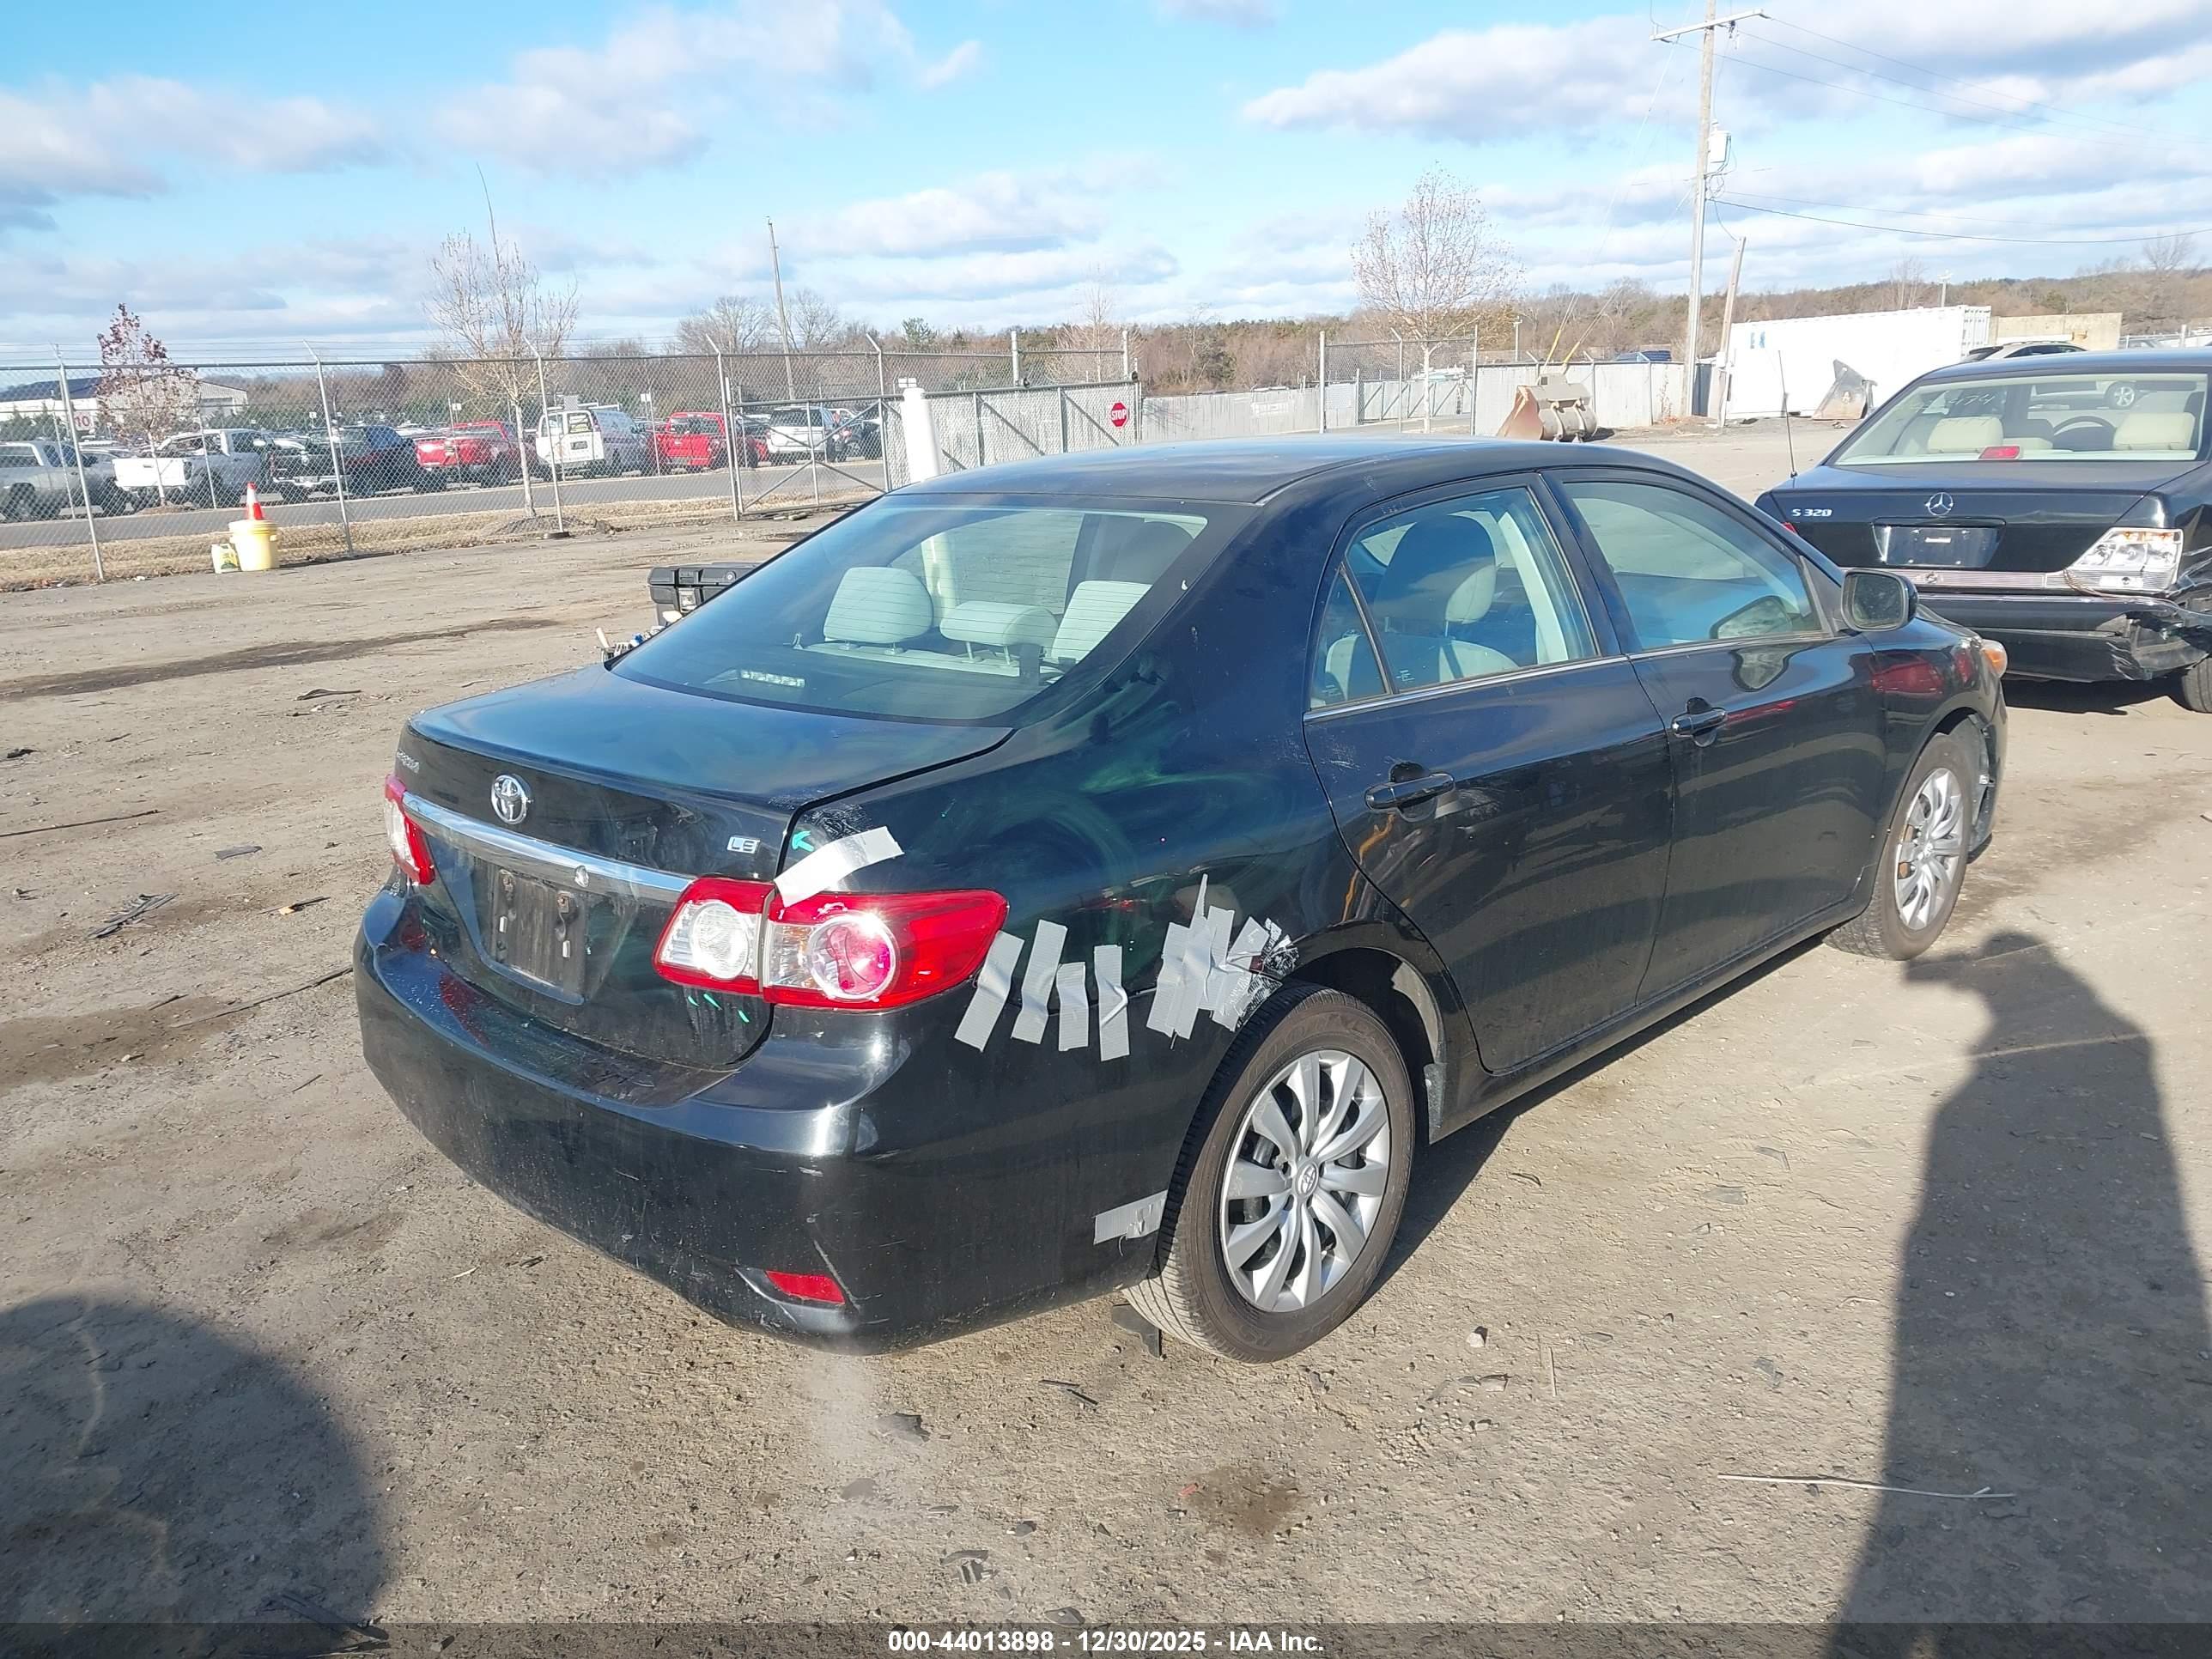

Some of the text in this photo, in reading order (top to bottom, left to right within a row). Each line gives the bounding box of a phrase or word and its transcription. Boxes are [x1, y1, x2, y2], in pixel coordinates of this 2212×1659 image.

[1111, 409, 1127, 421] STOP
[1791, 507, 1832, 517] S 320
[730, 837, 756, 852] LE
